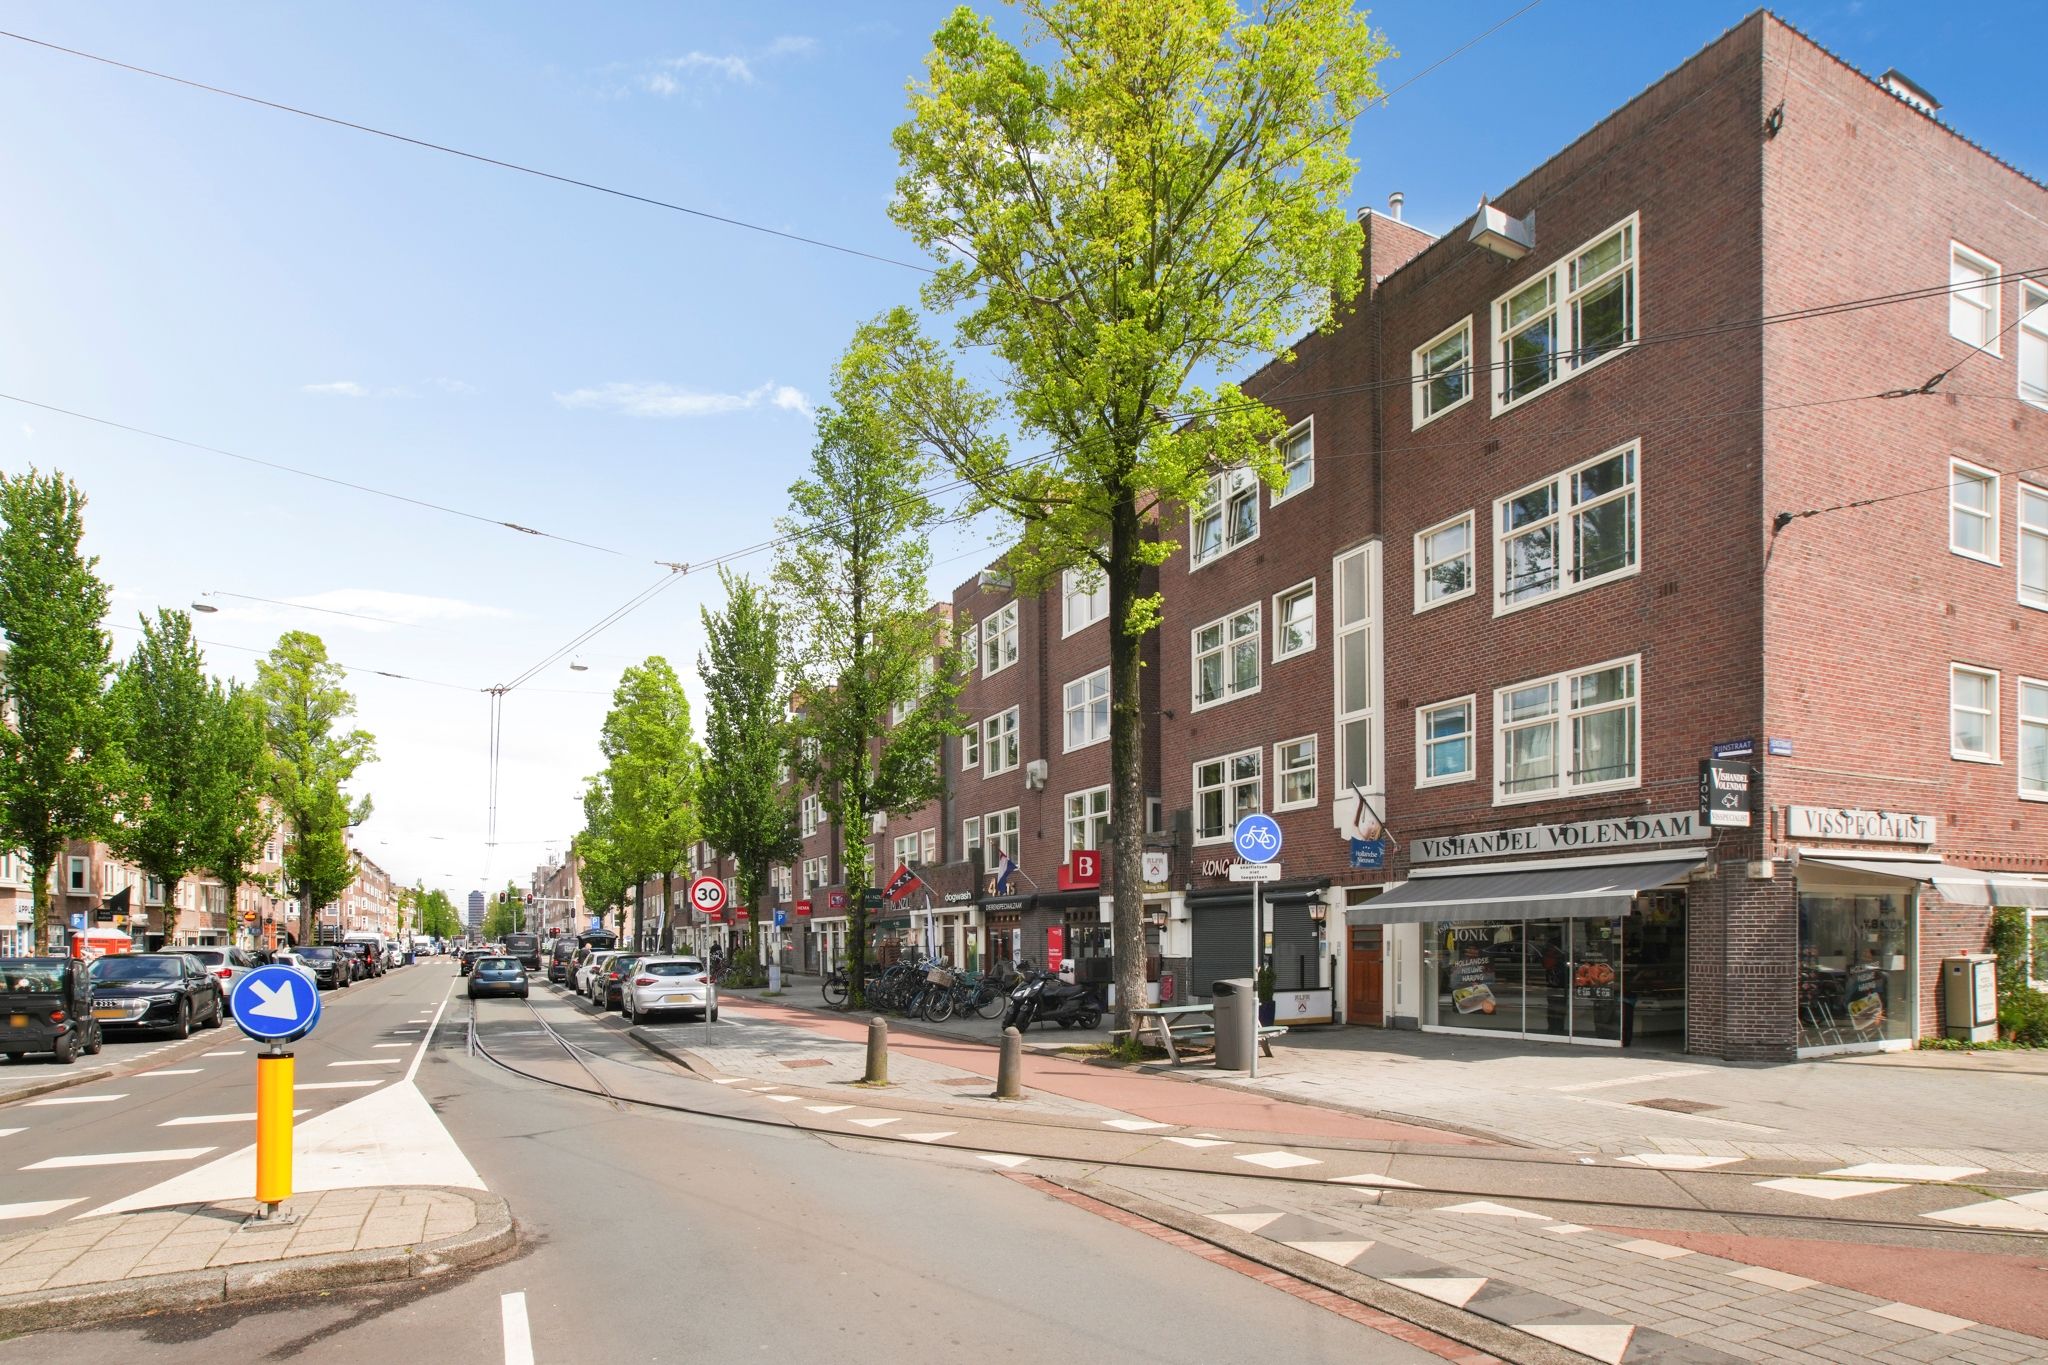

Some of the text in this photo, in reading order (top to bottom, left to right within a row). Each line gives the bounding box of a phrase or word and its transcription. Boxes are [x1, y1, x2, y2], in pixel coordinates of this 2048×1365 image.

[1714, 741, 1751, 752] RIJNSTRAAT
[1700, 773, 1708, 813] JONK
[1804, 810, 1927, 840] VISSPECIALIST
[1422, 816, 1692, 858] VISHANDEL VOLENDAM
[1079, 856, 1093, 877] B
[1202, 858, 1229, 878] KONG
[697, 888, 720, 901] 30
[944, 891, 971, 902] dogwash
[74, 917, 80, 925] P
[1453, 928, 1488, 942] JONK
[1455, 957, 1489, 967] HOLLANDSE
